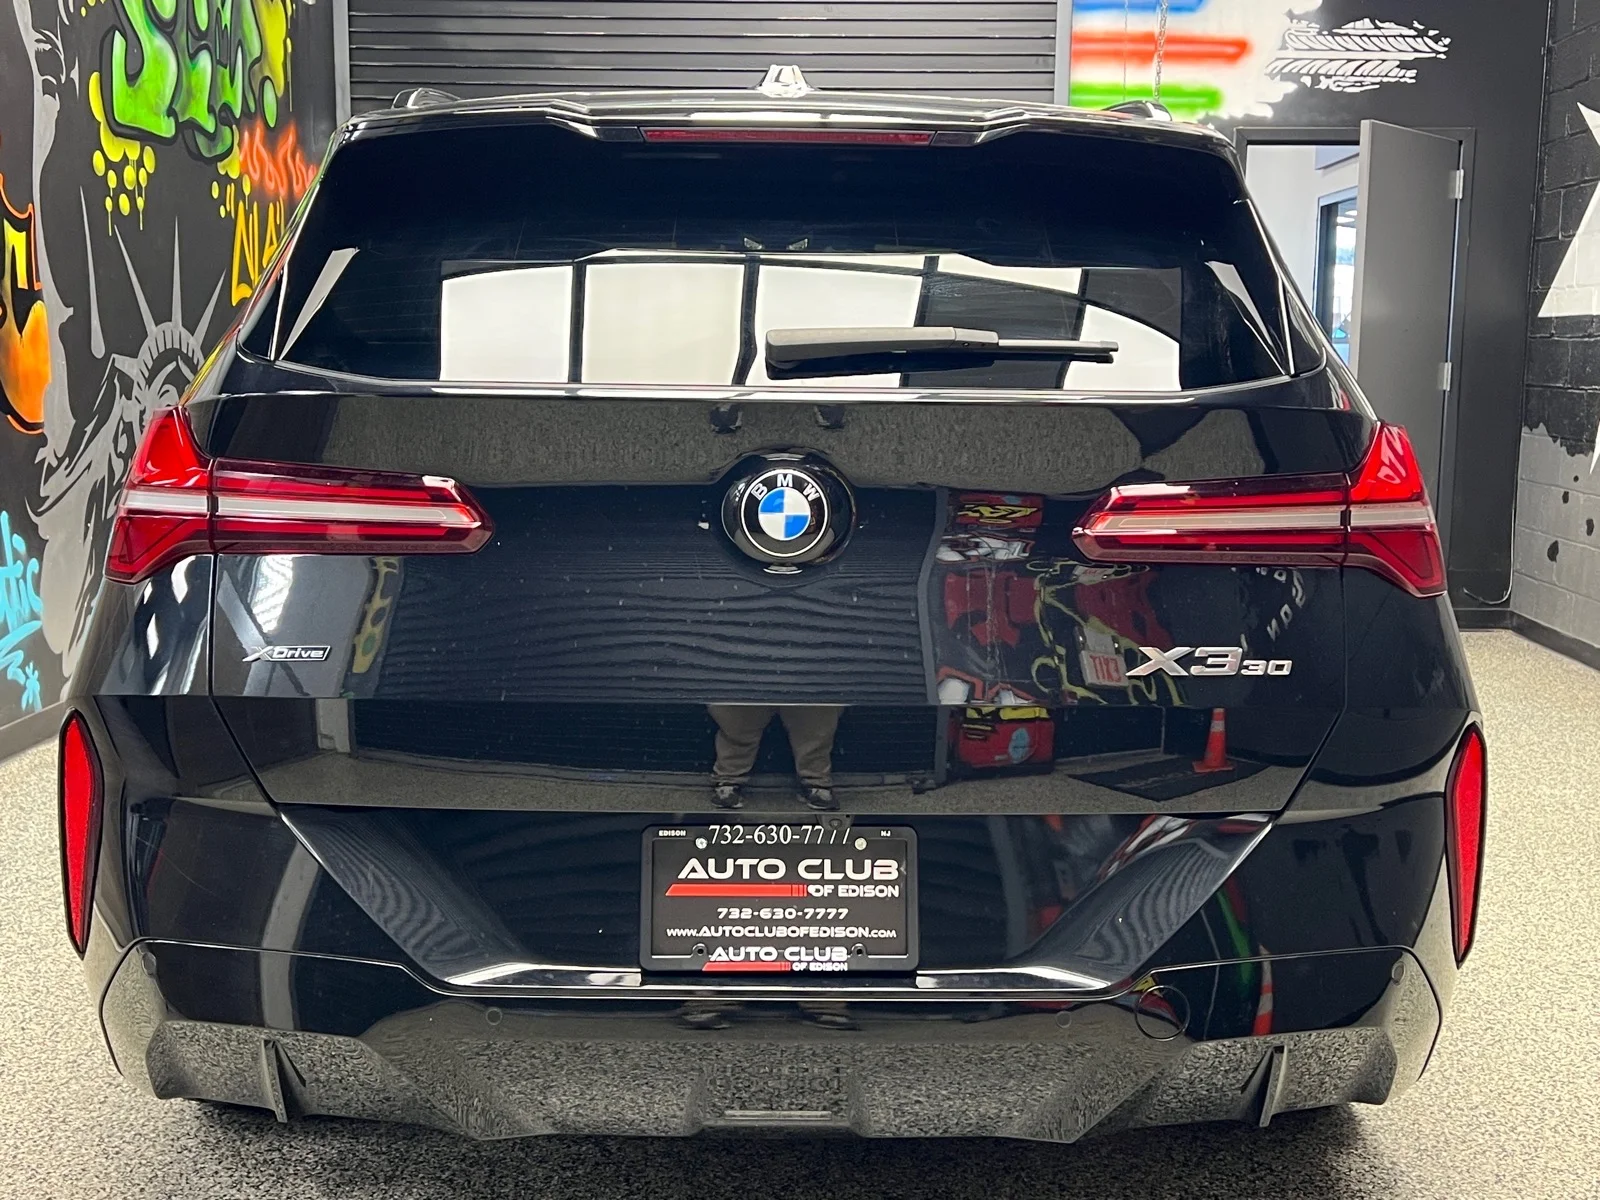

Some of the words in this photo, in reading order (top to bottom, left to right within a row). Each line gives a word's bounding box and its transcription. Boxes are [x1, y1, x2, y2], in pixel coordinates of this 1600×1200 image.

[751, 473, 820, 501] BMW
[677, 857, 787, 880] AUTO
[797, 858, 899, 880] CLUB
[807, 884, 833, 897] OF
[838, 884, 899, 897] EDISON
[717, 907, 849, 920] 732-630-7777
[709, 946, 778, 962] AUTO
[783, 946, 849, 962] CLUB
[791, 962, 806, 972] OF
[808, 962, 849, 972] EDISON
